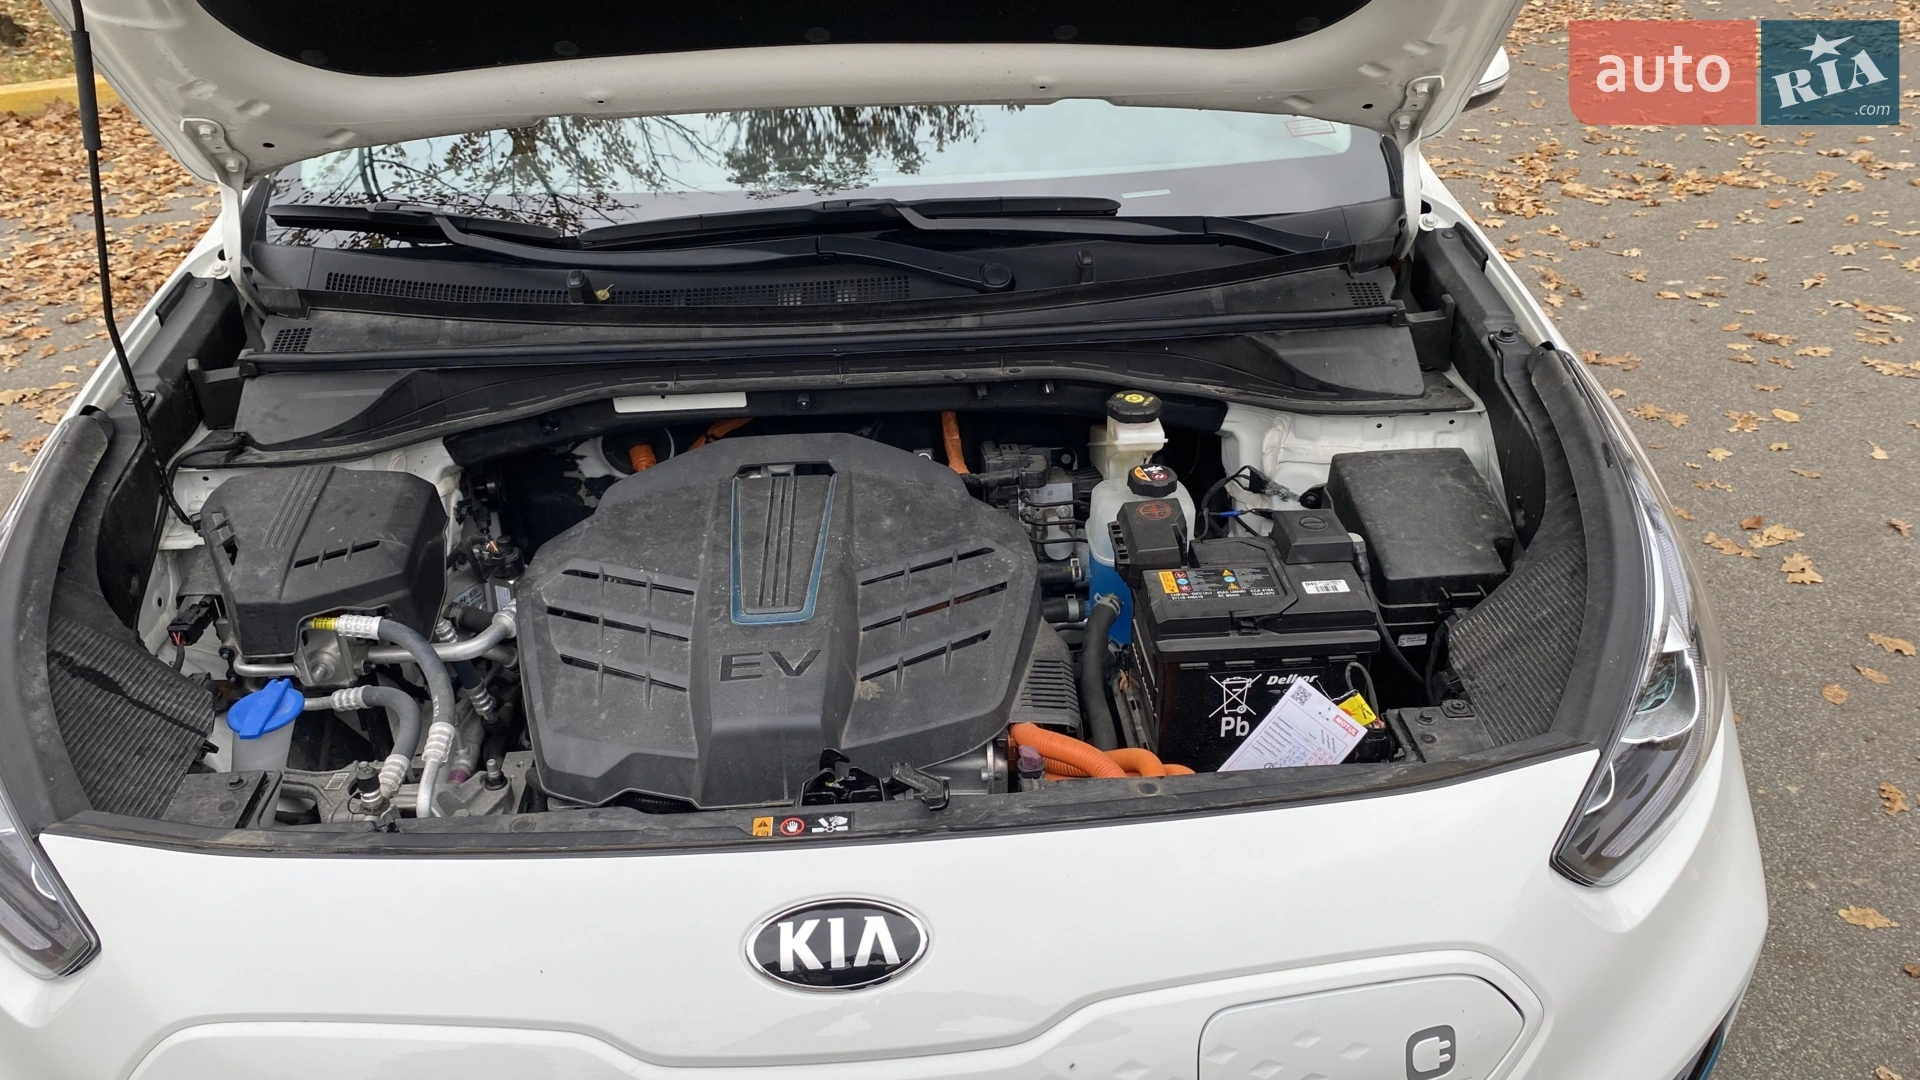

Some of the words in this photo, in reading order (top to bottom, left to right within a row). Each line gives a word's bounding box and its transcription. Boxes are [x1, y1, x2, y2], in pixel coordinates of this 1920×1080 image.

[719, 649, 823, 682] EV
[1220, 716, 1250, 738] Pb
[1334, 716, 1358, 736] MOTUL
[777, 915, 901, 972] KIA
